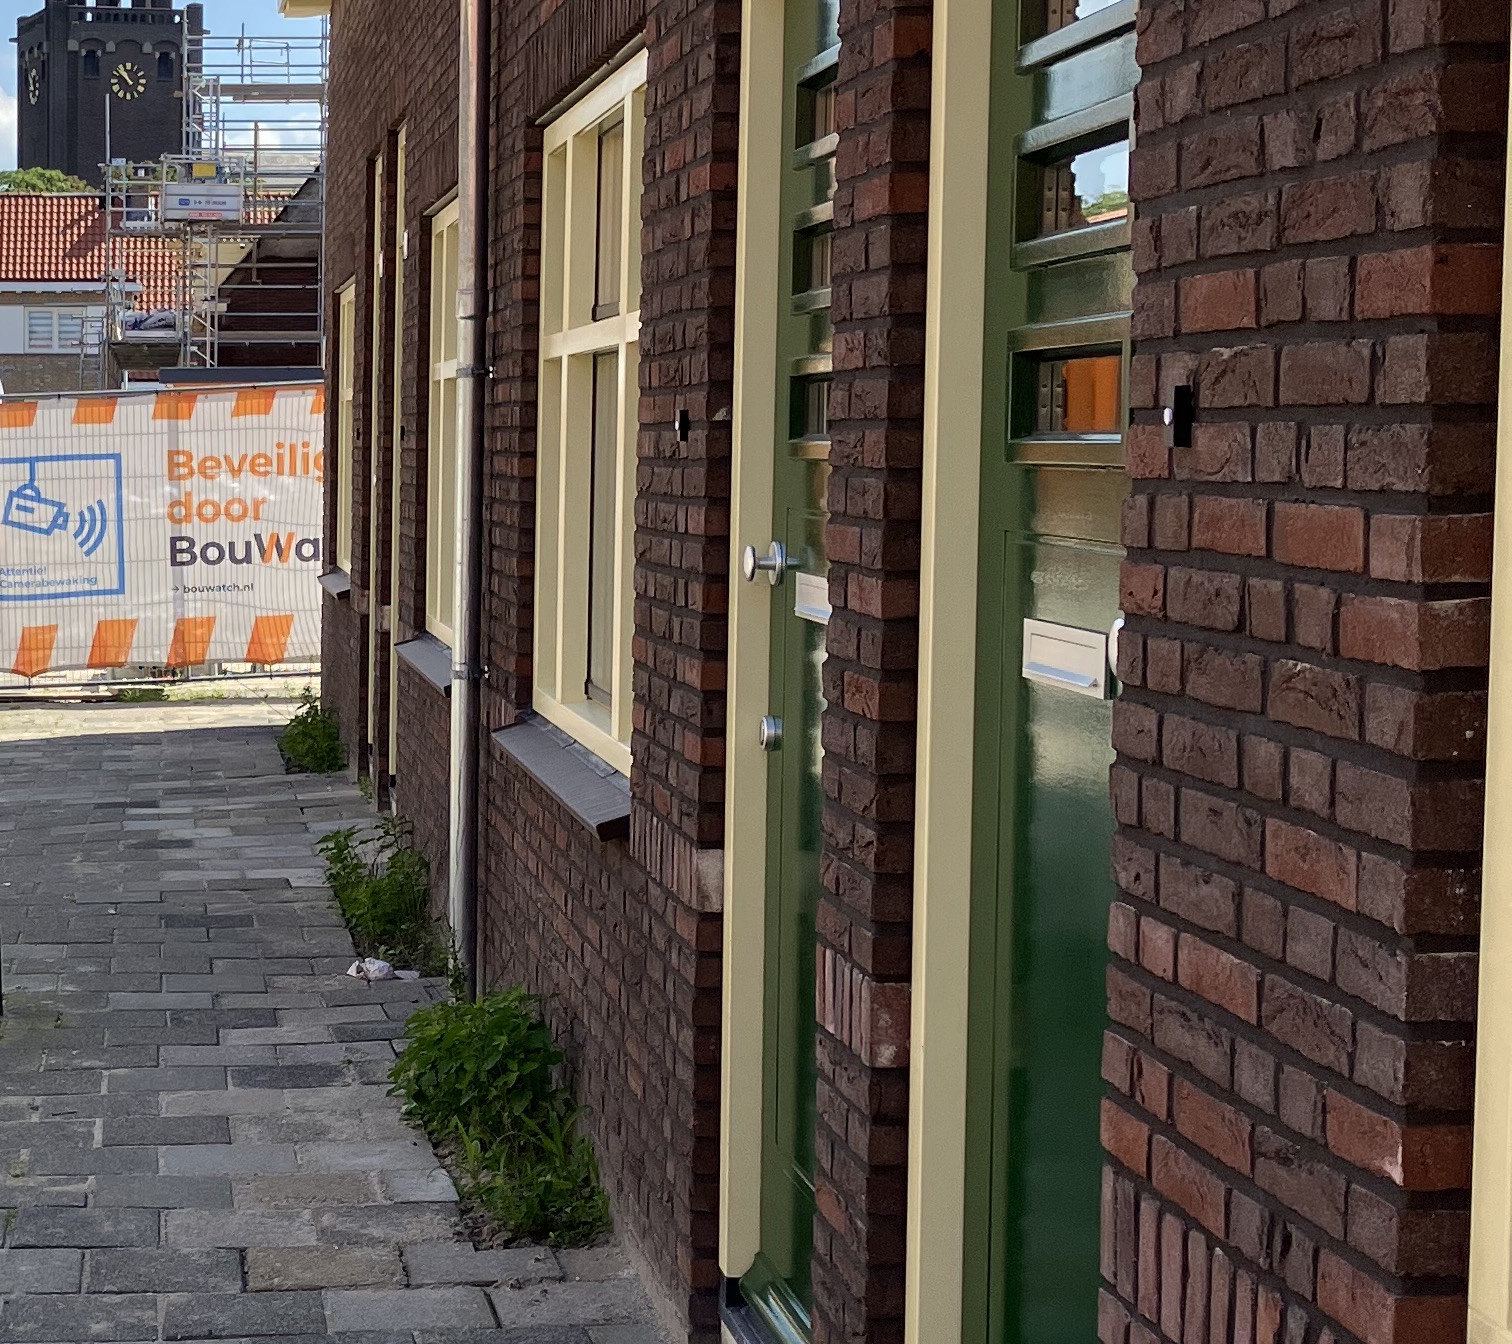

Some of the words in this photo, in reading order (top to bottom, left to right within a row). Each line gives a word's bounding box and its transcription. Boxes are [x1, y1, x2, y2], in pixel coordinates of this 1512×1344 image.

[166, 491, 268, 525] door
[0, 565, 47, 576] Attentie!
[0, 576, 98, 589] Camerabewaking
[183, 583, 254, 594] bouwatch.nl
